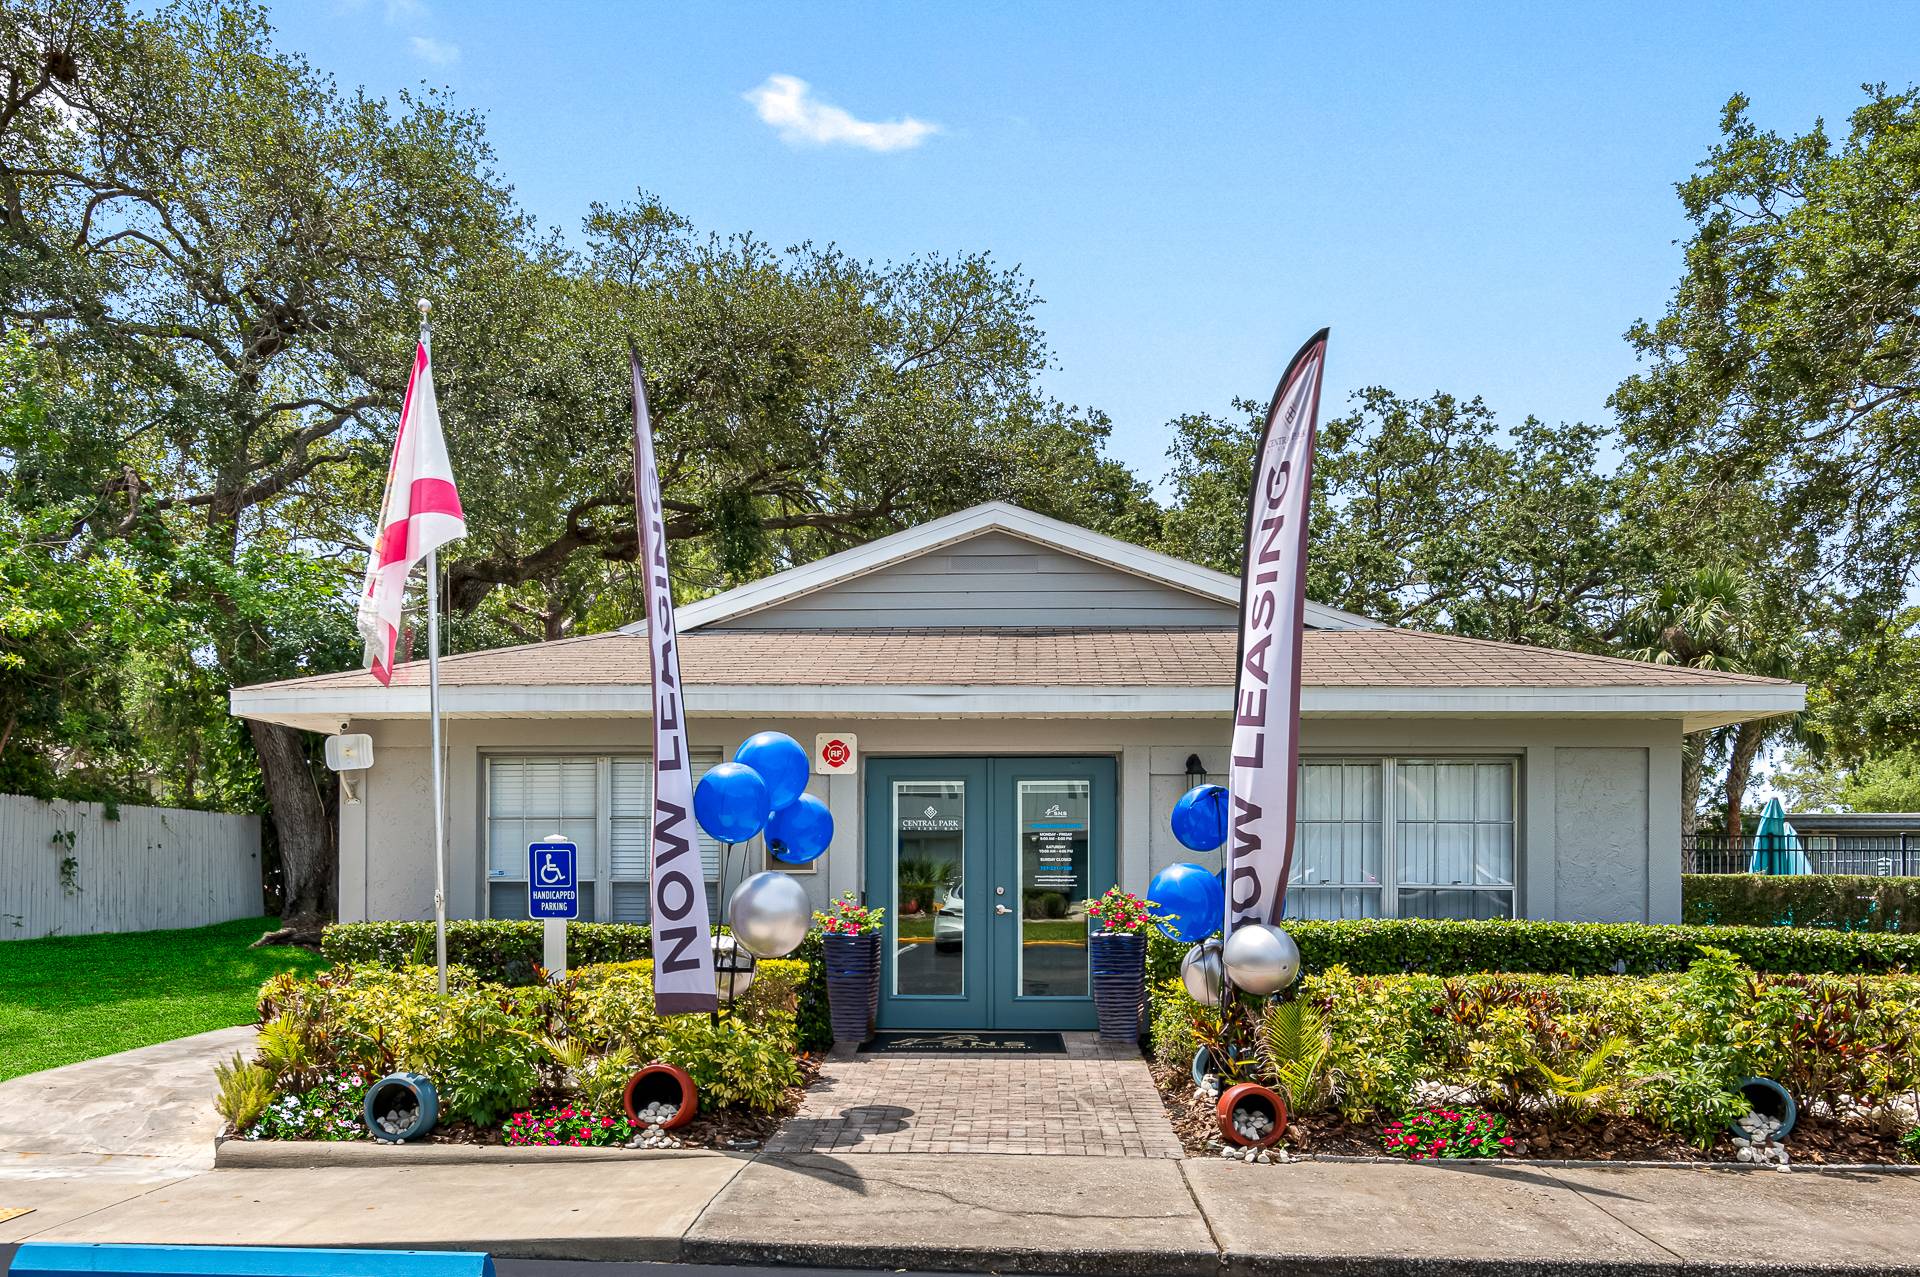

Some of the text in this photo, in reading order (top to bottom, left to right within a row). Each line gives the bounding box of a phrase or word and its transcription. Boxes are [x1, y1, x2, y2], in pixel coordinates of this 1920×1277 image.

[1234, 459, 1291, 769] LEASING
[648, 466, 701, 975] NOW LEASING
[532, 891, 575, 900] HANDICAPPED
[541, 902, 568, 911] PARKING
